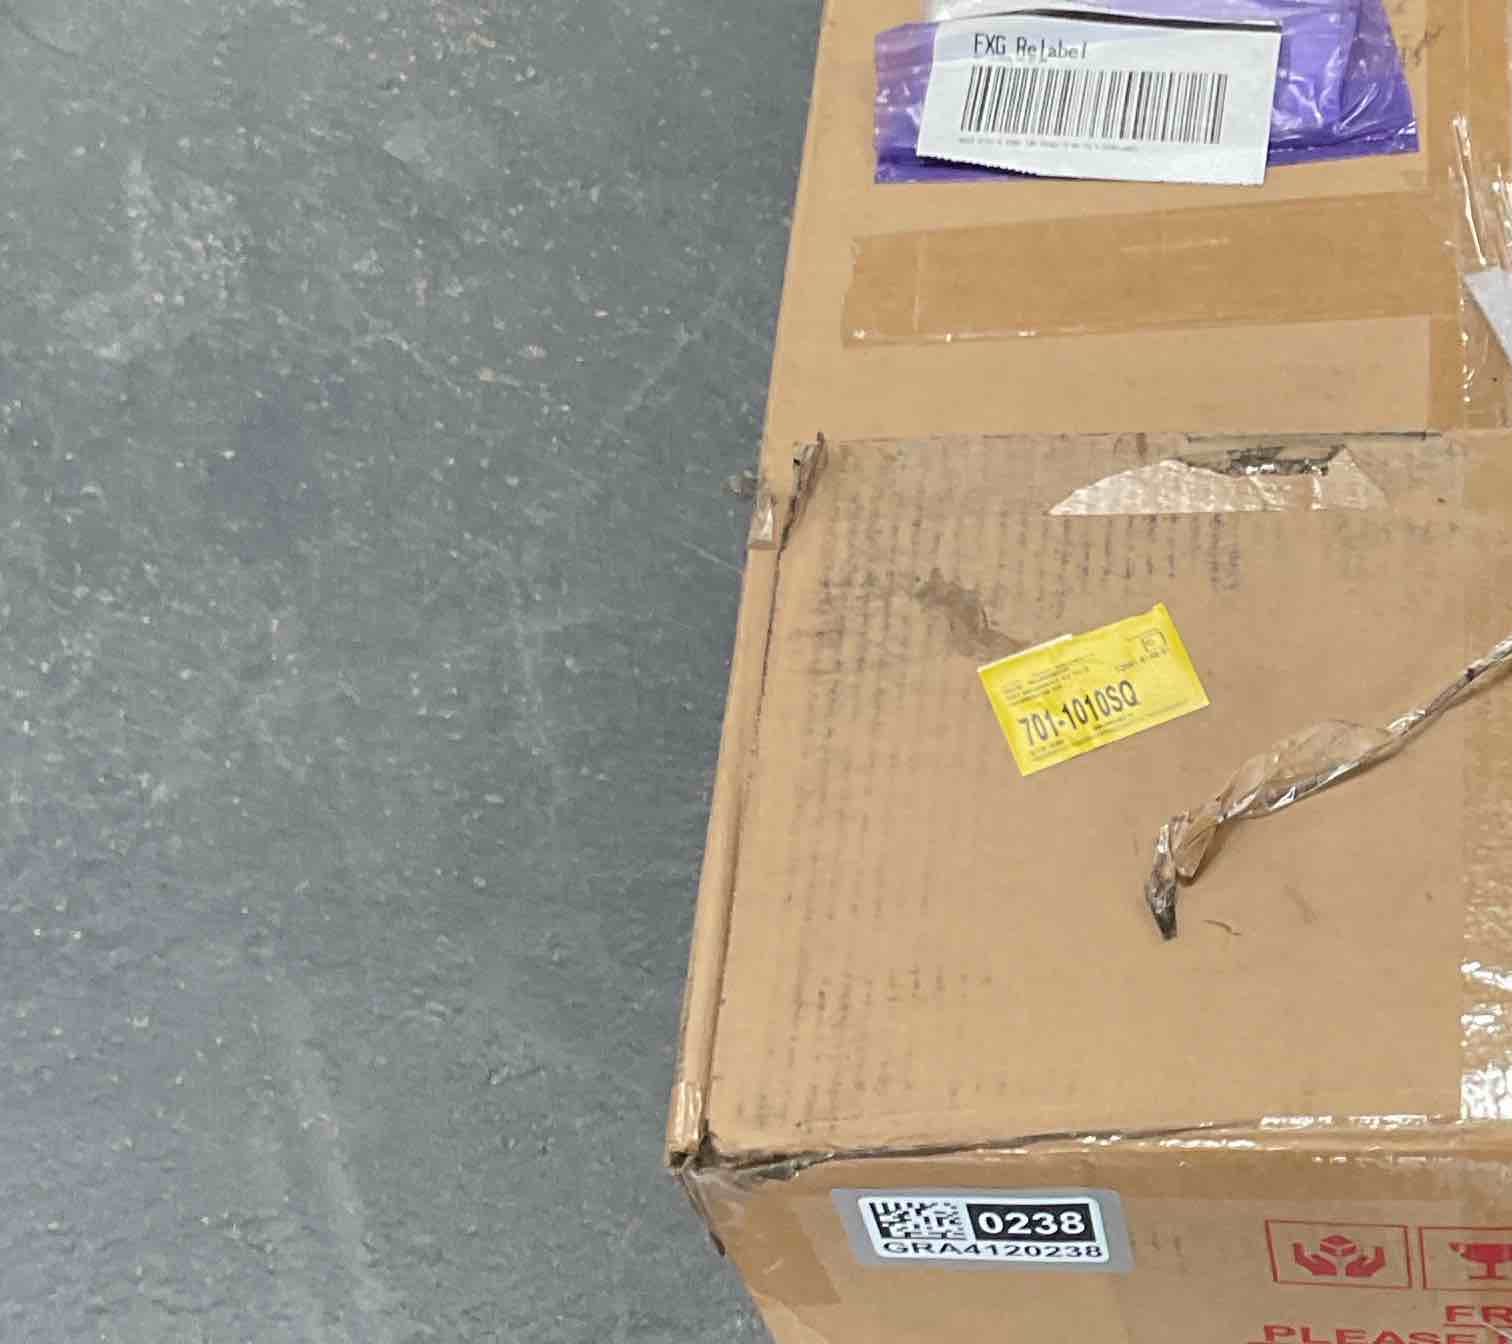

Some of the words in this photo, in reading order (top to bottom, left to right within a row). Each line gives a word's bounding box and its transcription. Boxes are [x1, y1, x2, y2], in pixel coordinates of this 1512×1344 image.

[973, 33, 1007, 57] FXG
[1017, 679, 1139, 747] 701-1010SQ
[977, 1211, 1087, 1235] 0238
[882, 1241, 1104, 1258] GRA4120238
